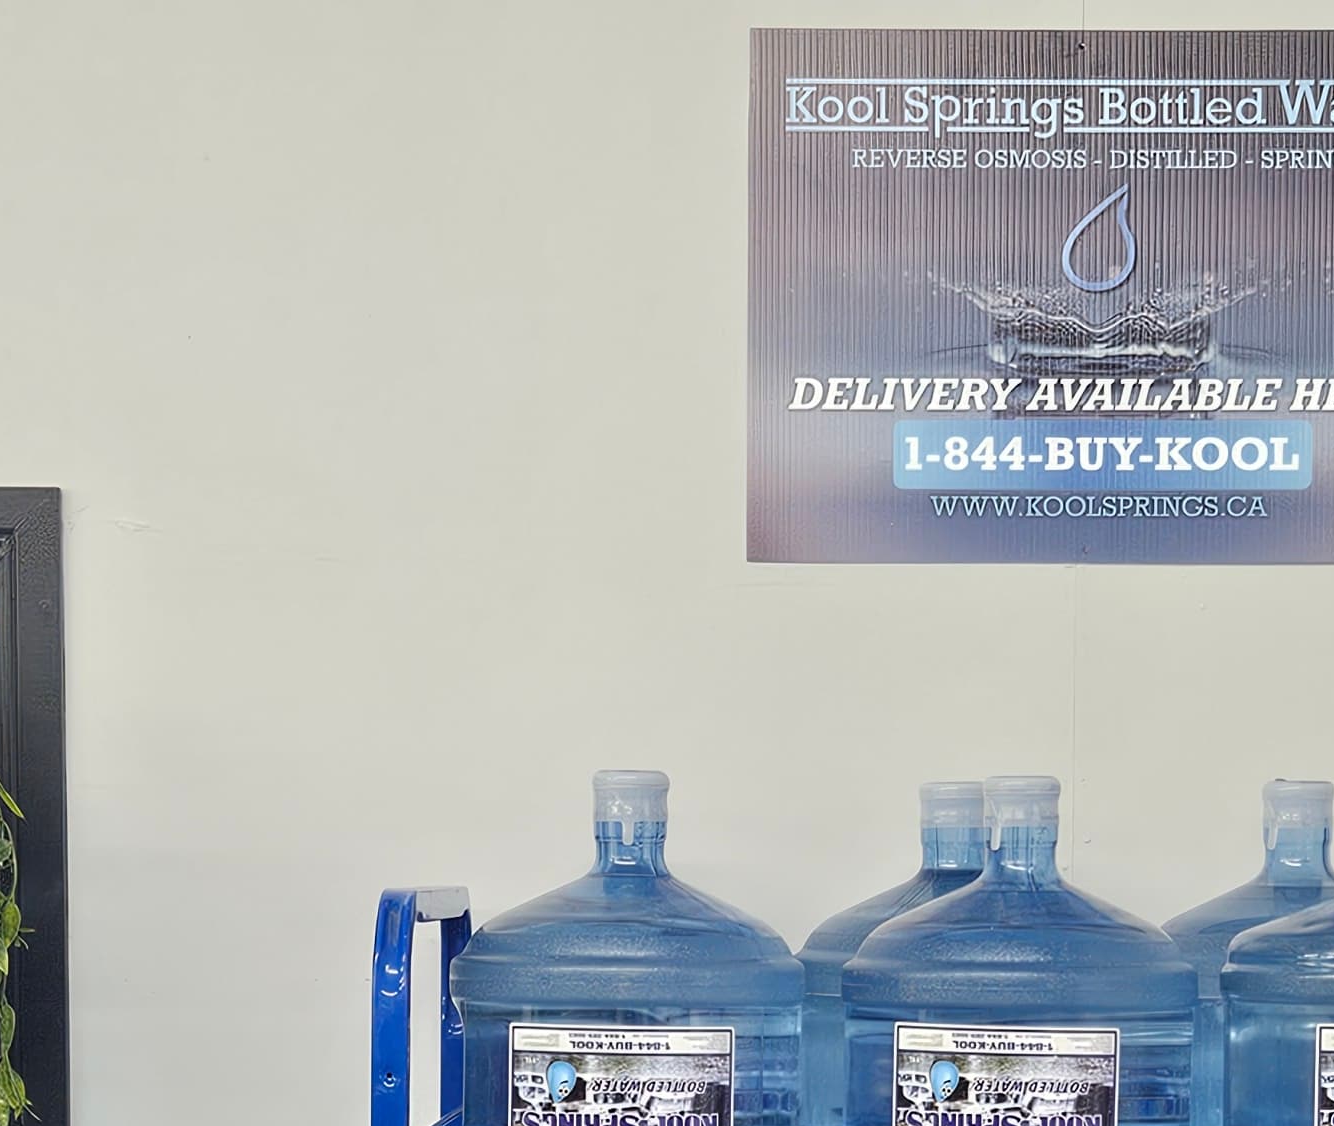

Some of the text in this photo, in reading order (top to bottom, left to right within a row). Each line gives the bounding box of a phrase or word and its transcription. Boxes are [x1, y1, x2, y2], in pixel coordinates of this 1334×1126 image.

[787, 86, 888, 126] Kool
[903, 85, 1084, 138] Springs
[1098, 85, 1265, 126] Bottled
[852, 147, 966, 170] REVERSE
[974, 147, 1086, 170] OSMOSIS
[1109, 148, 1237, 170] DISTILLED
[787, 376, 1024, 411] DELIVERY
[1024, 376, 1279, 411] AVAILABLE
[904, 435, 1300, 473] 1-844-BUY-KOOL
[930, 494, 1268, 518] WWW.KOOLSPRINGS.CA
[590, 1077, 707, 1094] BOTTLED WATER
[973, 1077, 1089, 1094] BOTTLED WATER
